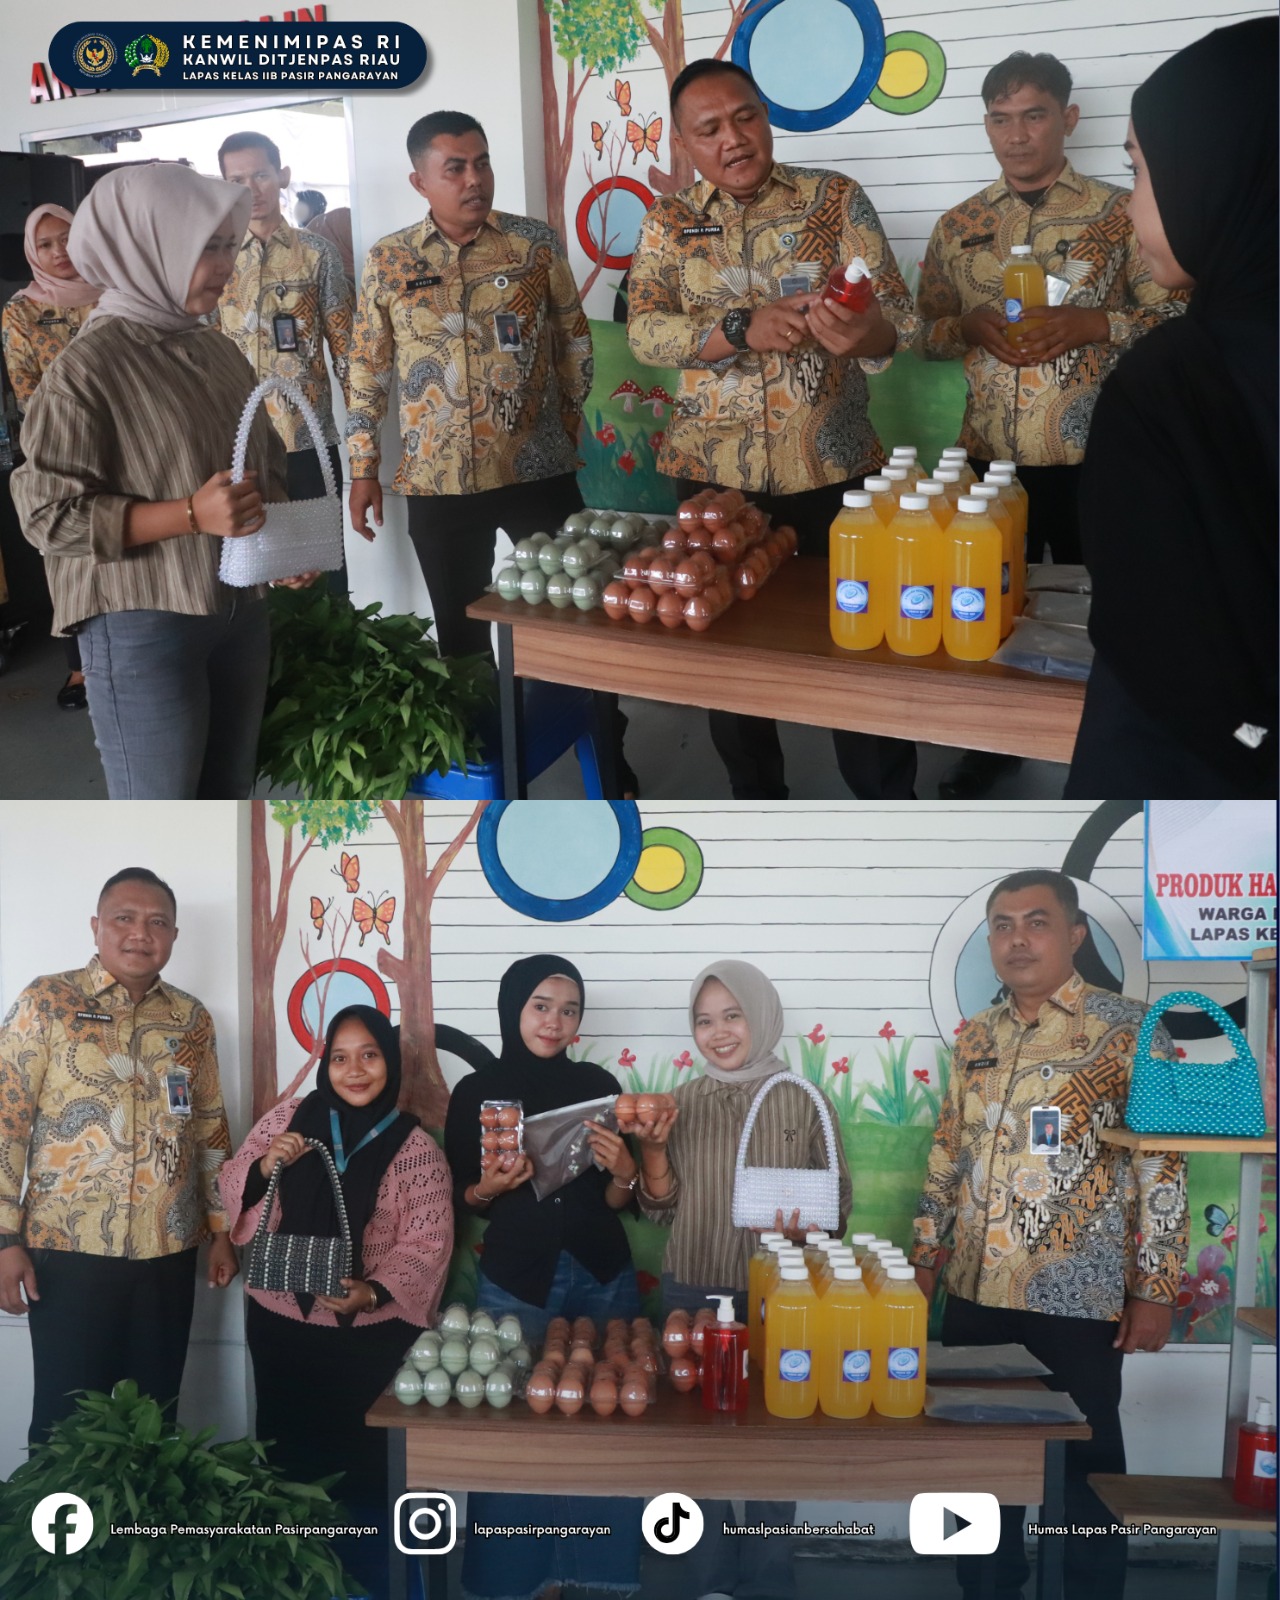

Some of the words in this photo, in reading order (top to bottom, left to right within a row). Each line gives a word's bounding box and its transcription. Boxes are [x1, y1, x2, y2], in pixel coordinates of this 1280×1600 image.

[1156, 873, 1244, 898] PRODUK
[1198, 907, 1267, 921] WARGA
[1190, 927, 1250, 941] LAPAS
